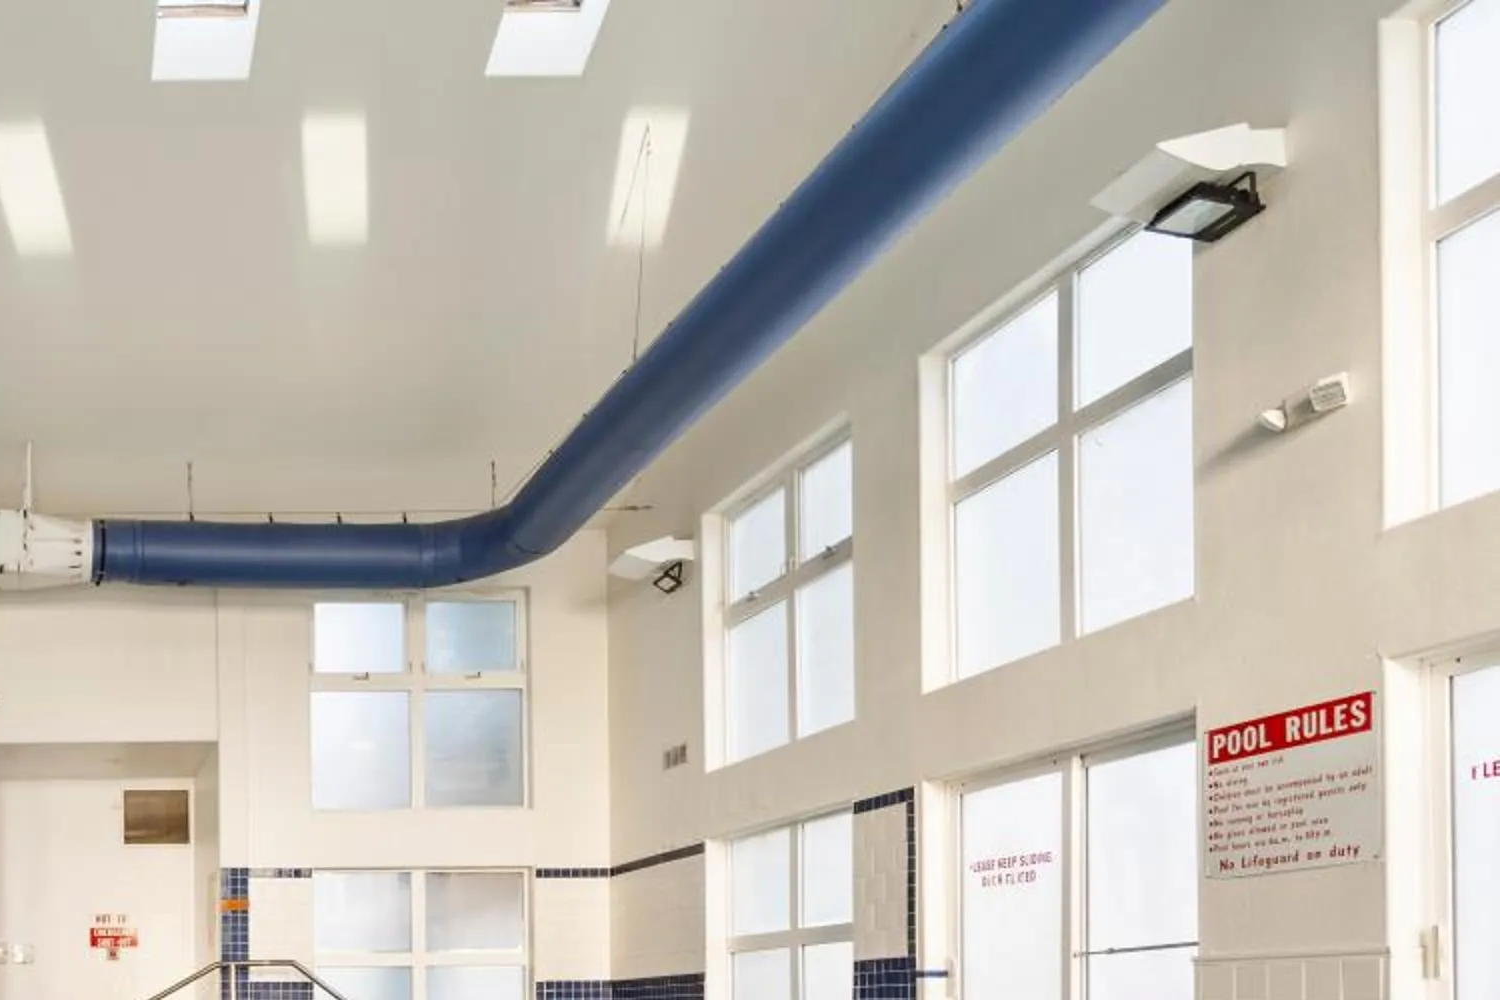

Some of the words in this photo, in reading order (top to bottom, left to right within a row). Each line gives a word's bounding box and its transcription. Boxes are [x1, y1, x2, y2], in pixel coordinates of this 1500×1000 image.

[1212, 723, 1272, 759] POOL
[1285, 700, 1367, 743] RULES
[1219, 858, 1235, 872] No
[1241, 849, 1299, 869] Lifeguard
[1307, 851, 1322, 860] on
[1329, 844, 1361, 859] duty
